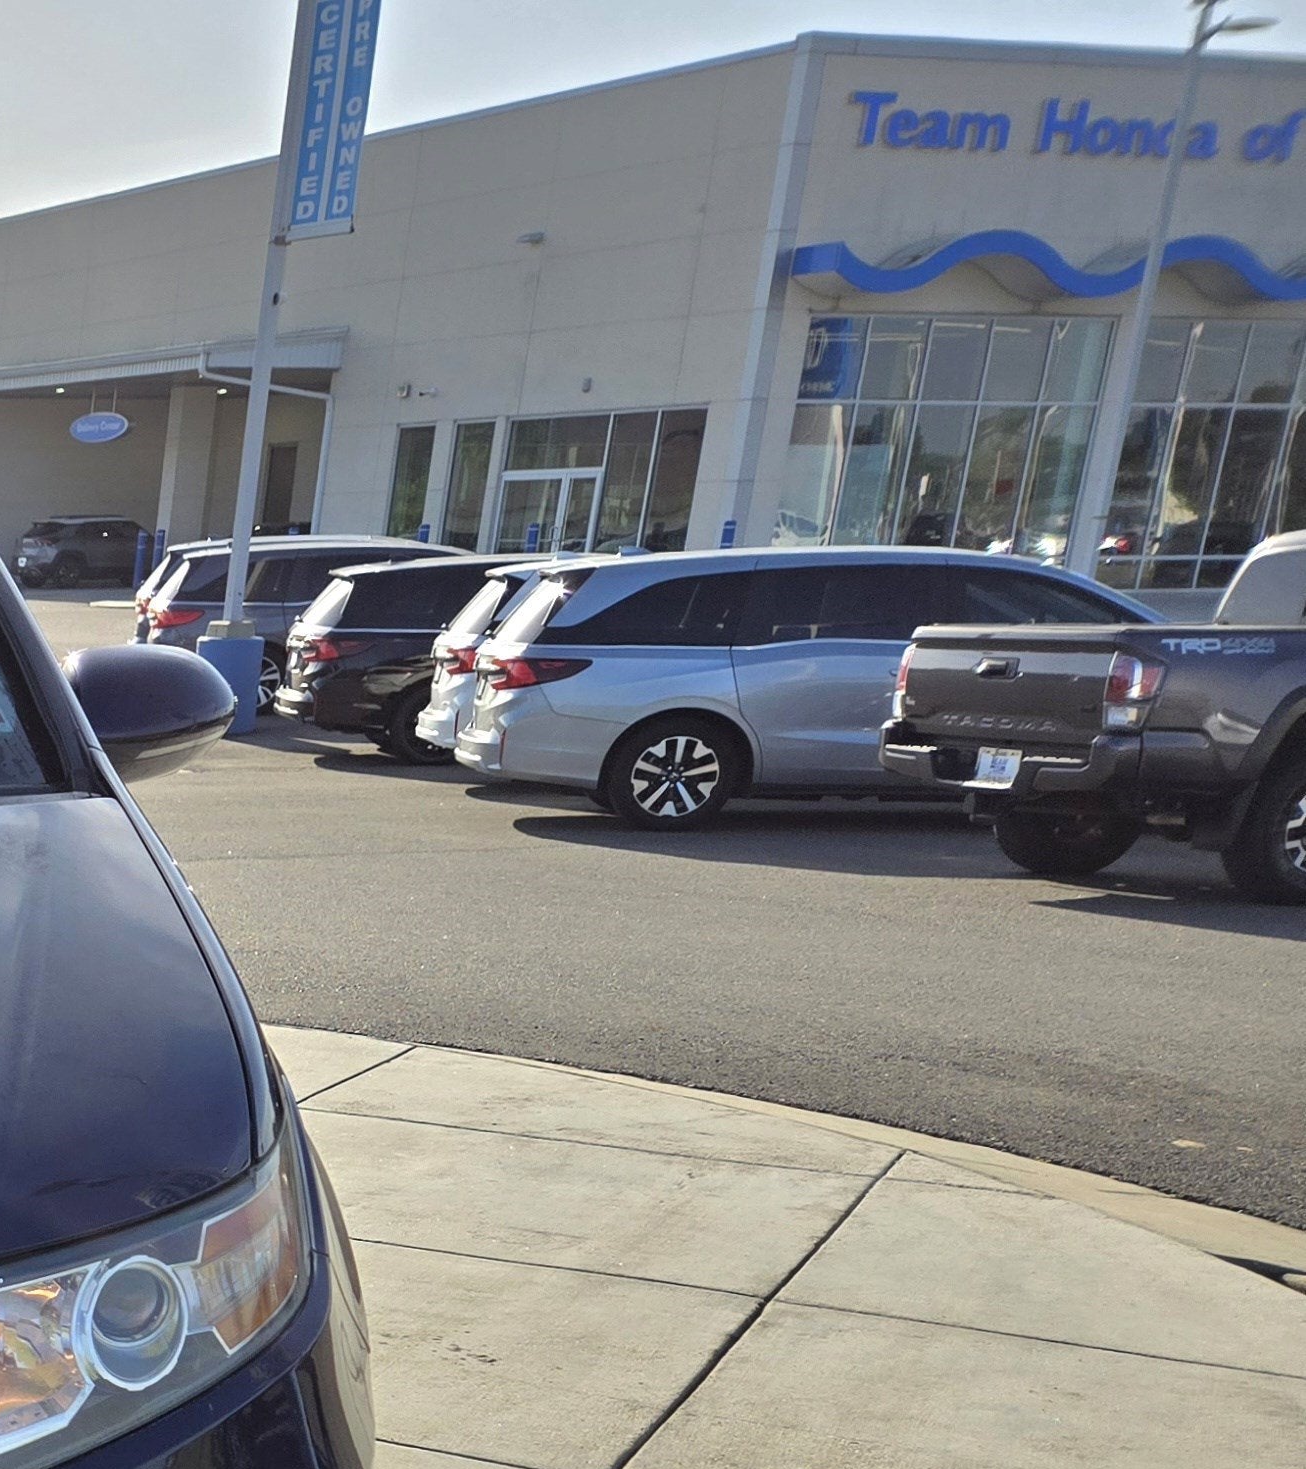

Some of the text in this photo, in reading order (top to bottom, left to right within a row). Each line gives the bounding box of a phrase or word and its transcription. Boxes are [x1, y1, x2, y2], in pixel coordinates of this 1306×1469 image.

[295, 4, 340, 220] CERTIFIED
[332, 0, 374, 217] PRE OWNED
[851, 90, 1011, 152] Team
[1242, 107, 1306, 163] of
[1161, 637, 1222, 655] TRD
